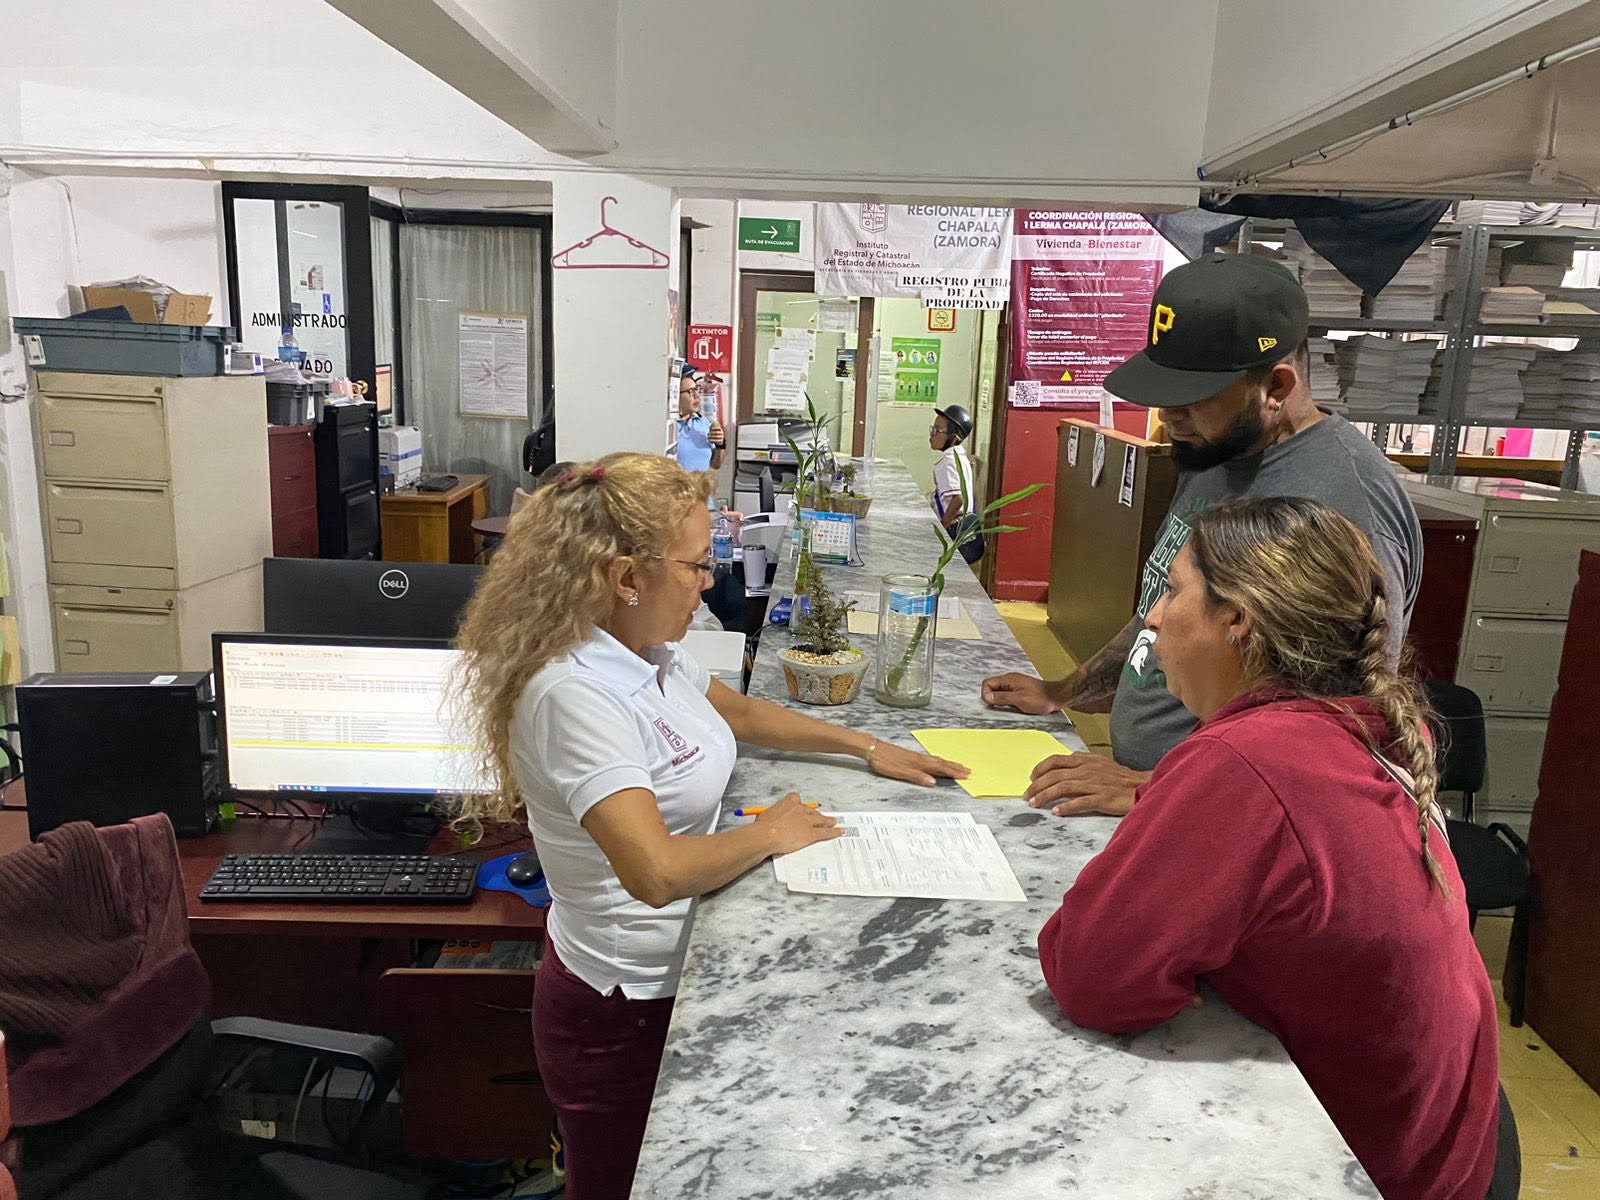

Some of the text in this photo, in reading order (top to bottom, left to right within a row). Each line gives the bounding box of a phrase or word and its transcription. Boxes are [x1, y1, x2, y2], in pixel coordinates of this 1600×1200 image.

[907, 206, 977, 218] REGIONAL
[1029, 211, 1103, 220] COORDINACIÓN
[938, 220, 1000, 233] CHAPALA
[1029, 221, 1062, 230] LERMA
[1062, 222, 1106, 230] CHAPALA
[856, 241, 889, 250] Instituto
[933, 235, 1002, 249] (ZAMORA)
[1036, 239, 1142, 249] Vivienda Bienestar
[834, 249, 868, 258] Registral
[876, 251, 911, 260] Catastral
[823, 258, 920, 268] del Estado de Michoacán
[903, 276, 969, 286] REGISTRO
[973, 277, 1011, 287] PUBLI
[947, 288, 985, 298] DE LA
[926, 298, 1000, 309] PROPIEDAD
[1152, 304, 1176, 345] P
[691, 328, 728, 336] EXTINTOR
[383, 579, 406, 589] DELL
